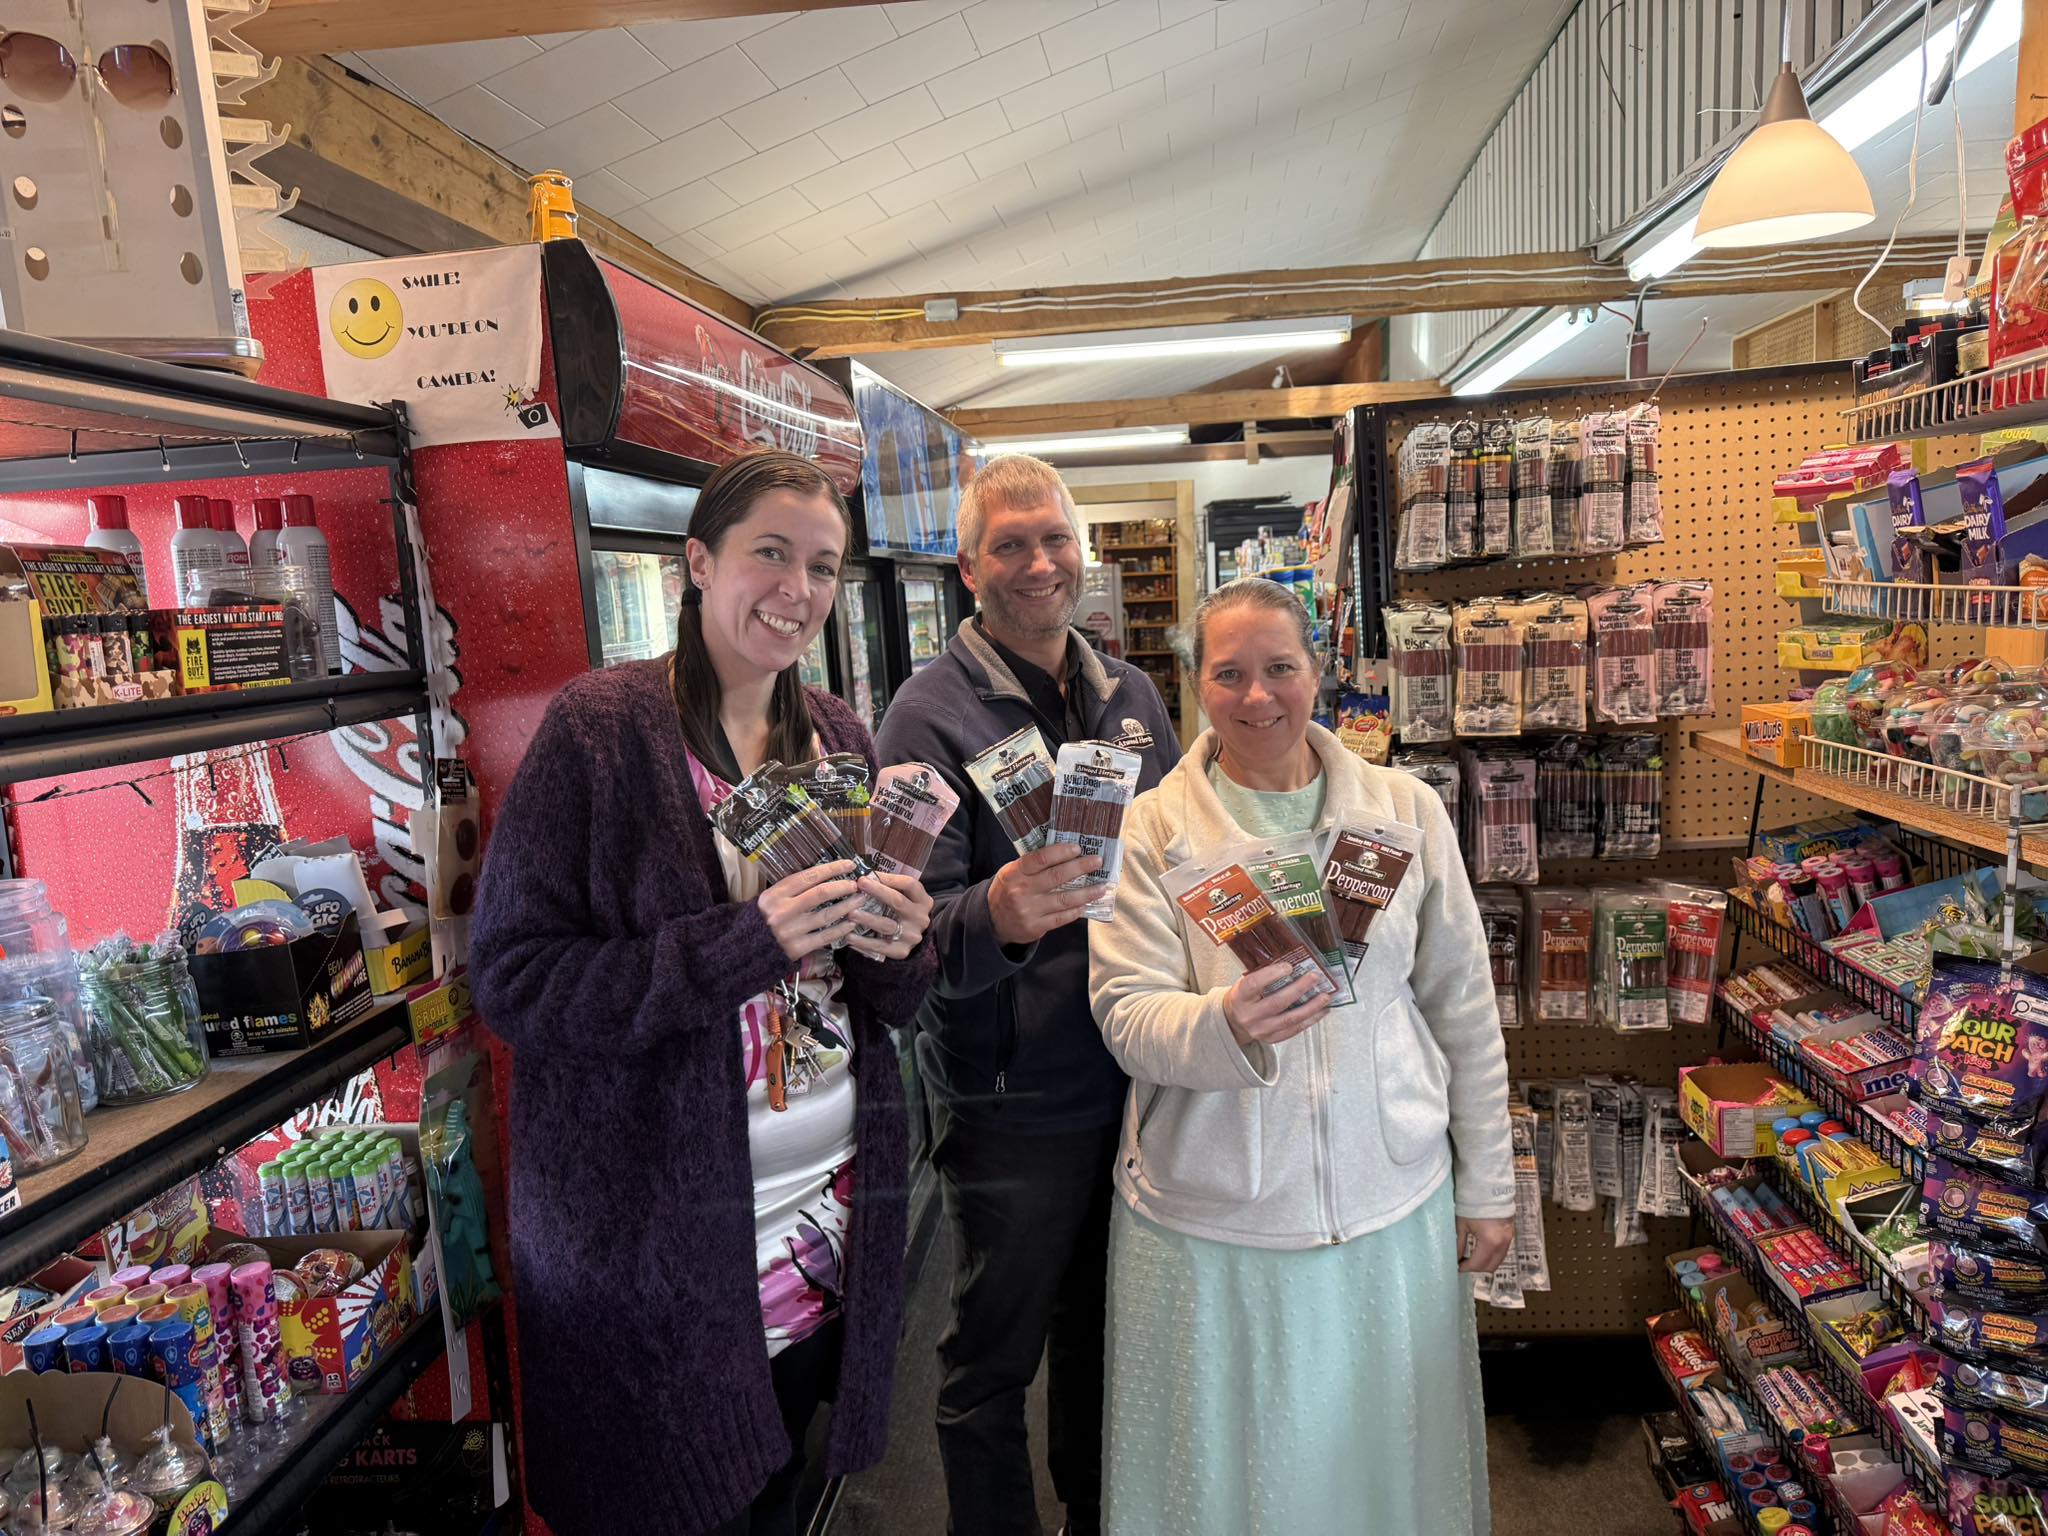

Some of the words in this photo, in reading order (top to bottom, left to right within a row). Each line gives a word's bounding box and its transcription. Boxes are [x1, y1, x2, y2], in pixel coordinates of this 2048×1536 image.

[402, 271, 460, 289] SMILE!
[407, 321, 472, 339] YOU'RE
[474, 317, 499, 334] ON
[417, 369, 496, 389] CAMERA!
[1891, 513, 1913, 526] DAIRY
[1964, 512, 1991, 527] DAIRY
[1968, 527, 1990, 541] MILK
[35, 573, 81, 597] FIRE
[177, 614, 192, 625] THE
[194, 614, 221, 625] EASIEST
[223, 613, 238, 624] WAY
[239, 612, 247, 623] TO
[247, 611, 265, 622] START
[186, 656, 203, 667] FIRE
[187, 666, 204, 677] GUYZ
[113, 687, 142, 698] K-LITE
[1745, 722, 1760, 740] Milk
[1762, 720, 1782, 740] Duds
[1063, 774, 1083, 786] Wild
[1076, 764, 1098, 775] Atwood
[1098, 767, 1124, 780] Heritage
[994, 780, 1031, 807] Bison
[1062, 784, 1095, 797] Sanglier
[1079, 835, 1104, 848] Game
[873, 852, 897, 871] Game
[315, 901, 341, 914] UFO
[190, 911, 207, 929] UFO
[1199, 895, 1277, 945] Pepperoni
[1542, 929, 1588, 953] Pepperoni
[1616, 936, 1665, 960] Pepperoni
[353, 967, 368, 988] FIRE
[242, 1012, 298, 1030] flames
[1876, 1029, 1910, 1057] mentos
[1964, 1053, 1992, 1069] Kids
[1976, 1202, 2028, 1219] BRILLANTS
[3, 1312, 40, 1343] NEATO!
[1982, 1314, 2013, 1329] GLOW
[1982, 1325, 2036, 1343] BRILLANTS
[327, 1373, 339, 1382] 12
[1783, 1370, 1813, 1405] mentos
[356, 1448, 417, 1467] KARTS
